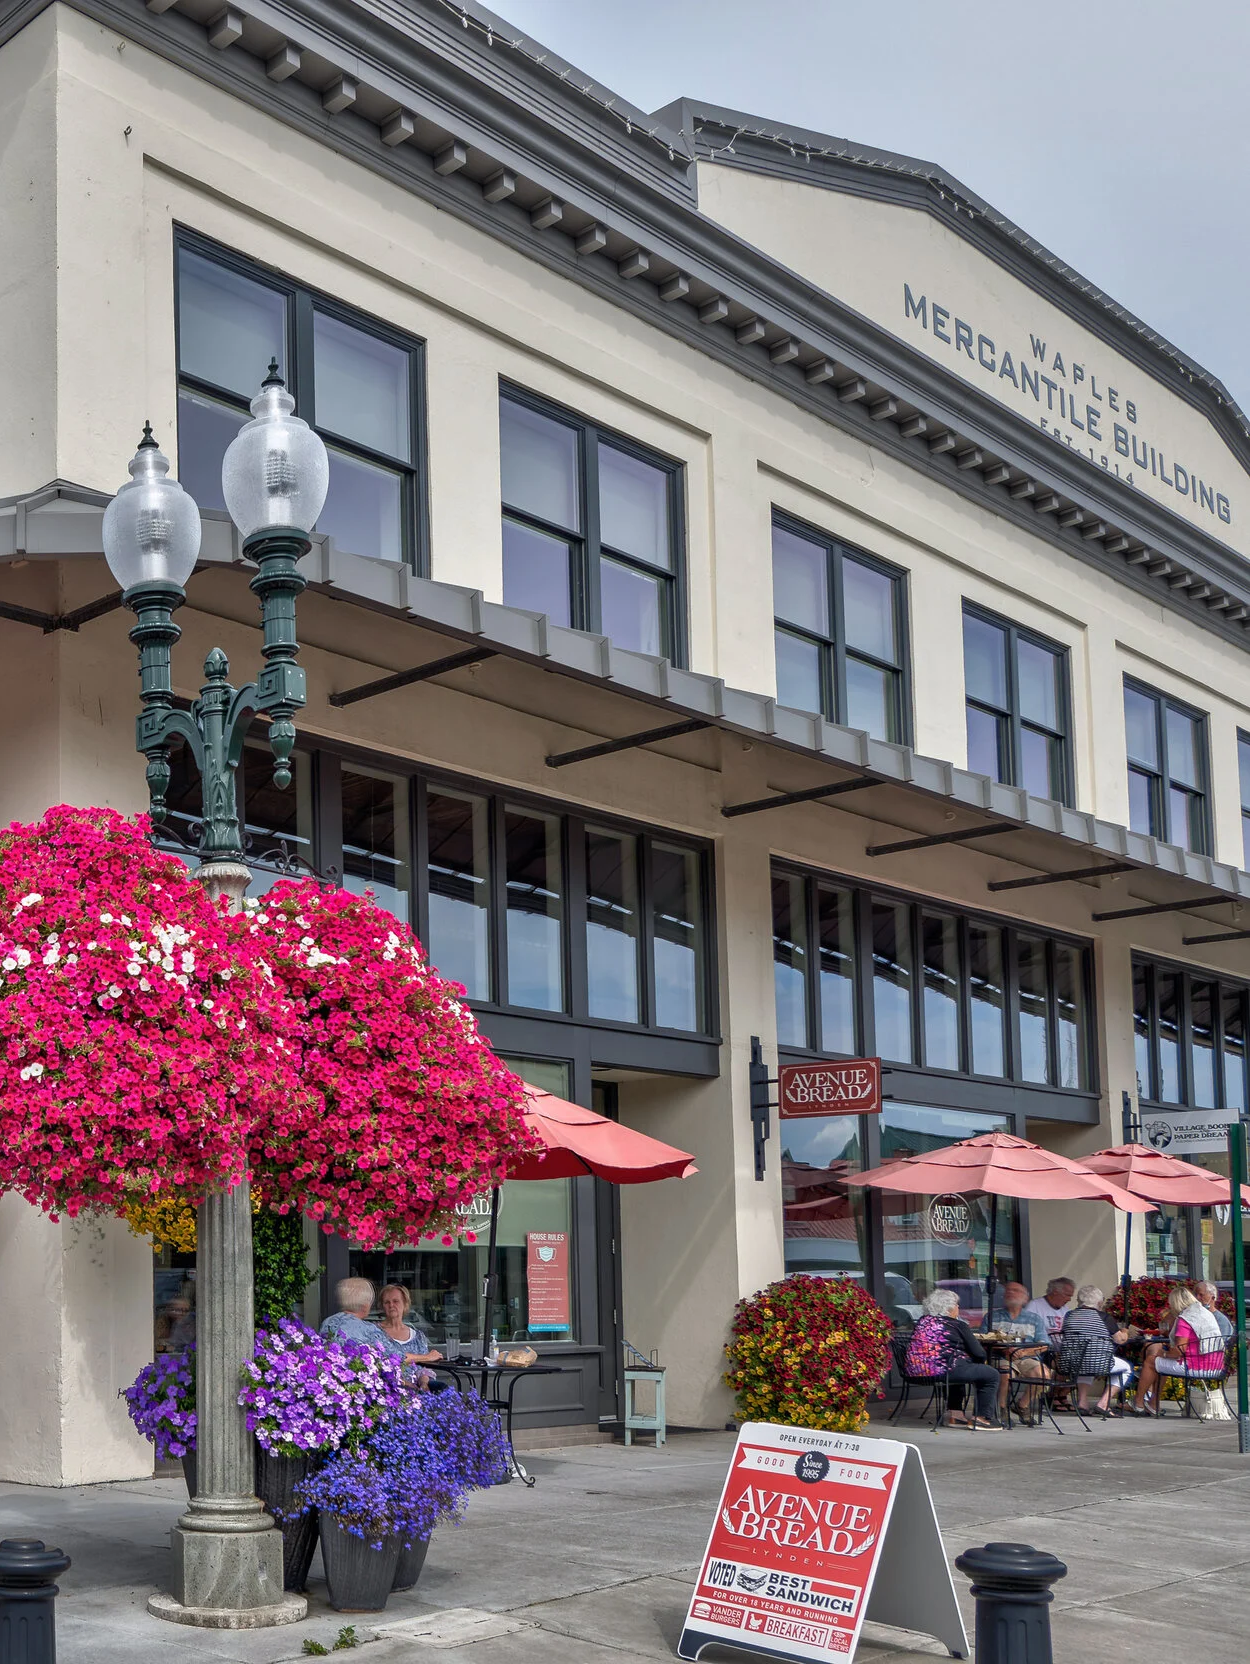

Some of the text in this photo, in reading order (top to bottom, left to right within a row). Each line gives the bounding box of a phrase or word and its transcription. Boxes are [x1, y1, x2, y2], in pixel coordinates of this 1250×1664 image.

[1029, 333, 1137, 424] WAPLES
[903, 283, 1231, 524] MERCANTILE BUILDING
[790, 1069, 867, 1089] AVENUE
[795, 1085, 862, 1103] BREAD
[933, 1204, 968, 1220] AVENUE
[936, 1218, 966, 1233] BREAD
[529, 1232, 565, 1241] HOUSE RULES
[779, 1434, 796, 1443] OPEN
[799, 1436, 832, 1448] EVERYDAY
[844, 1442, 860, 1452] 7:30
[756, 1456, 785, 1468] GOOD
[802, 1453, 823, 1469] Since
[801, 1468, 820, 1479] 1995
[839, 1468, 869, 1481] FOOD
[730, 1484, 872, 1533] AVENUE
[736, 1510, 854, 1556] BREAD
[752, 1548, 824, 1567] LYNDEN
[707, 1560, 737, 1587] VOTED
[768, 1572, 810, 1590] BEST
[712, 1590, 727, 1599] FOR
[729, 1594, 748, 1604] OVER
[760, 1601, 784, 1612] YEARS
[786, 1606, 802, 1616] AND
[803, 1610, 839, 1624] RUNNING
[765, 1584, 854, 1613] SANDWICH
[710, 1613, 740, 1626] BURGERS
[712, 1605, 742, 1619] VANDER
[766, 1619, 826, 1643] BREAKFAST
[829, 1643, 850, 1653] BREWS
[830, 1637, 848, 1645] LOCAL
